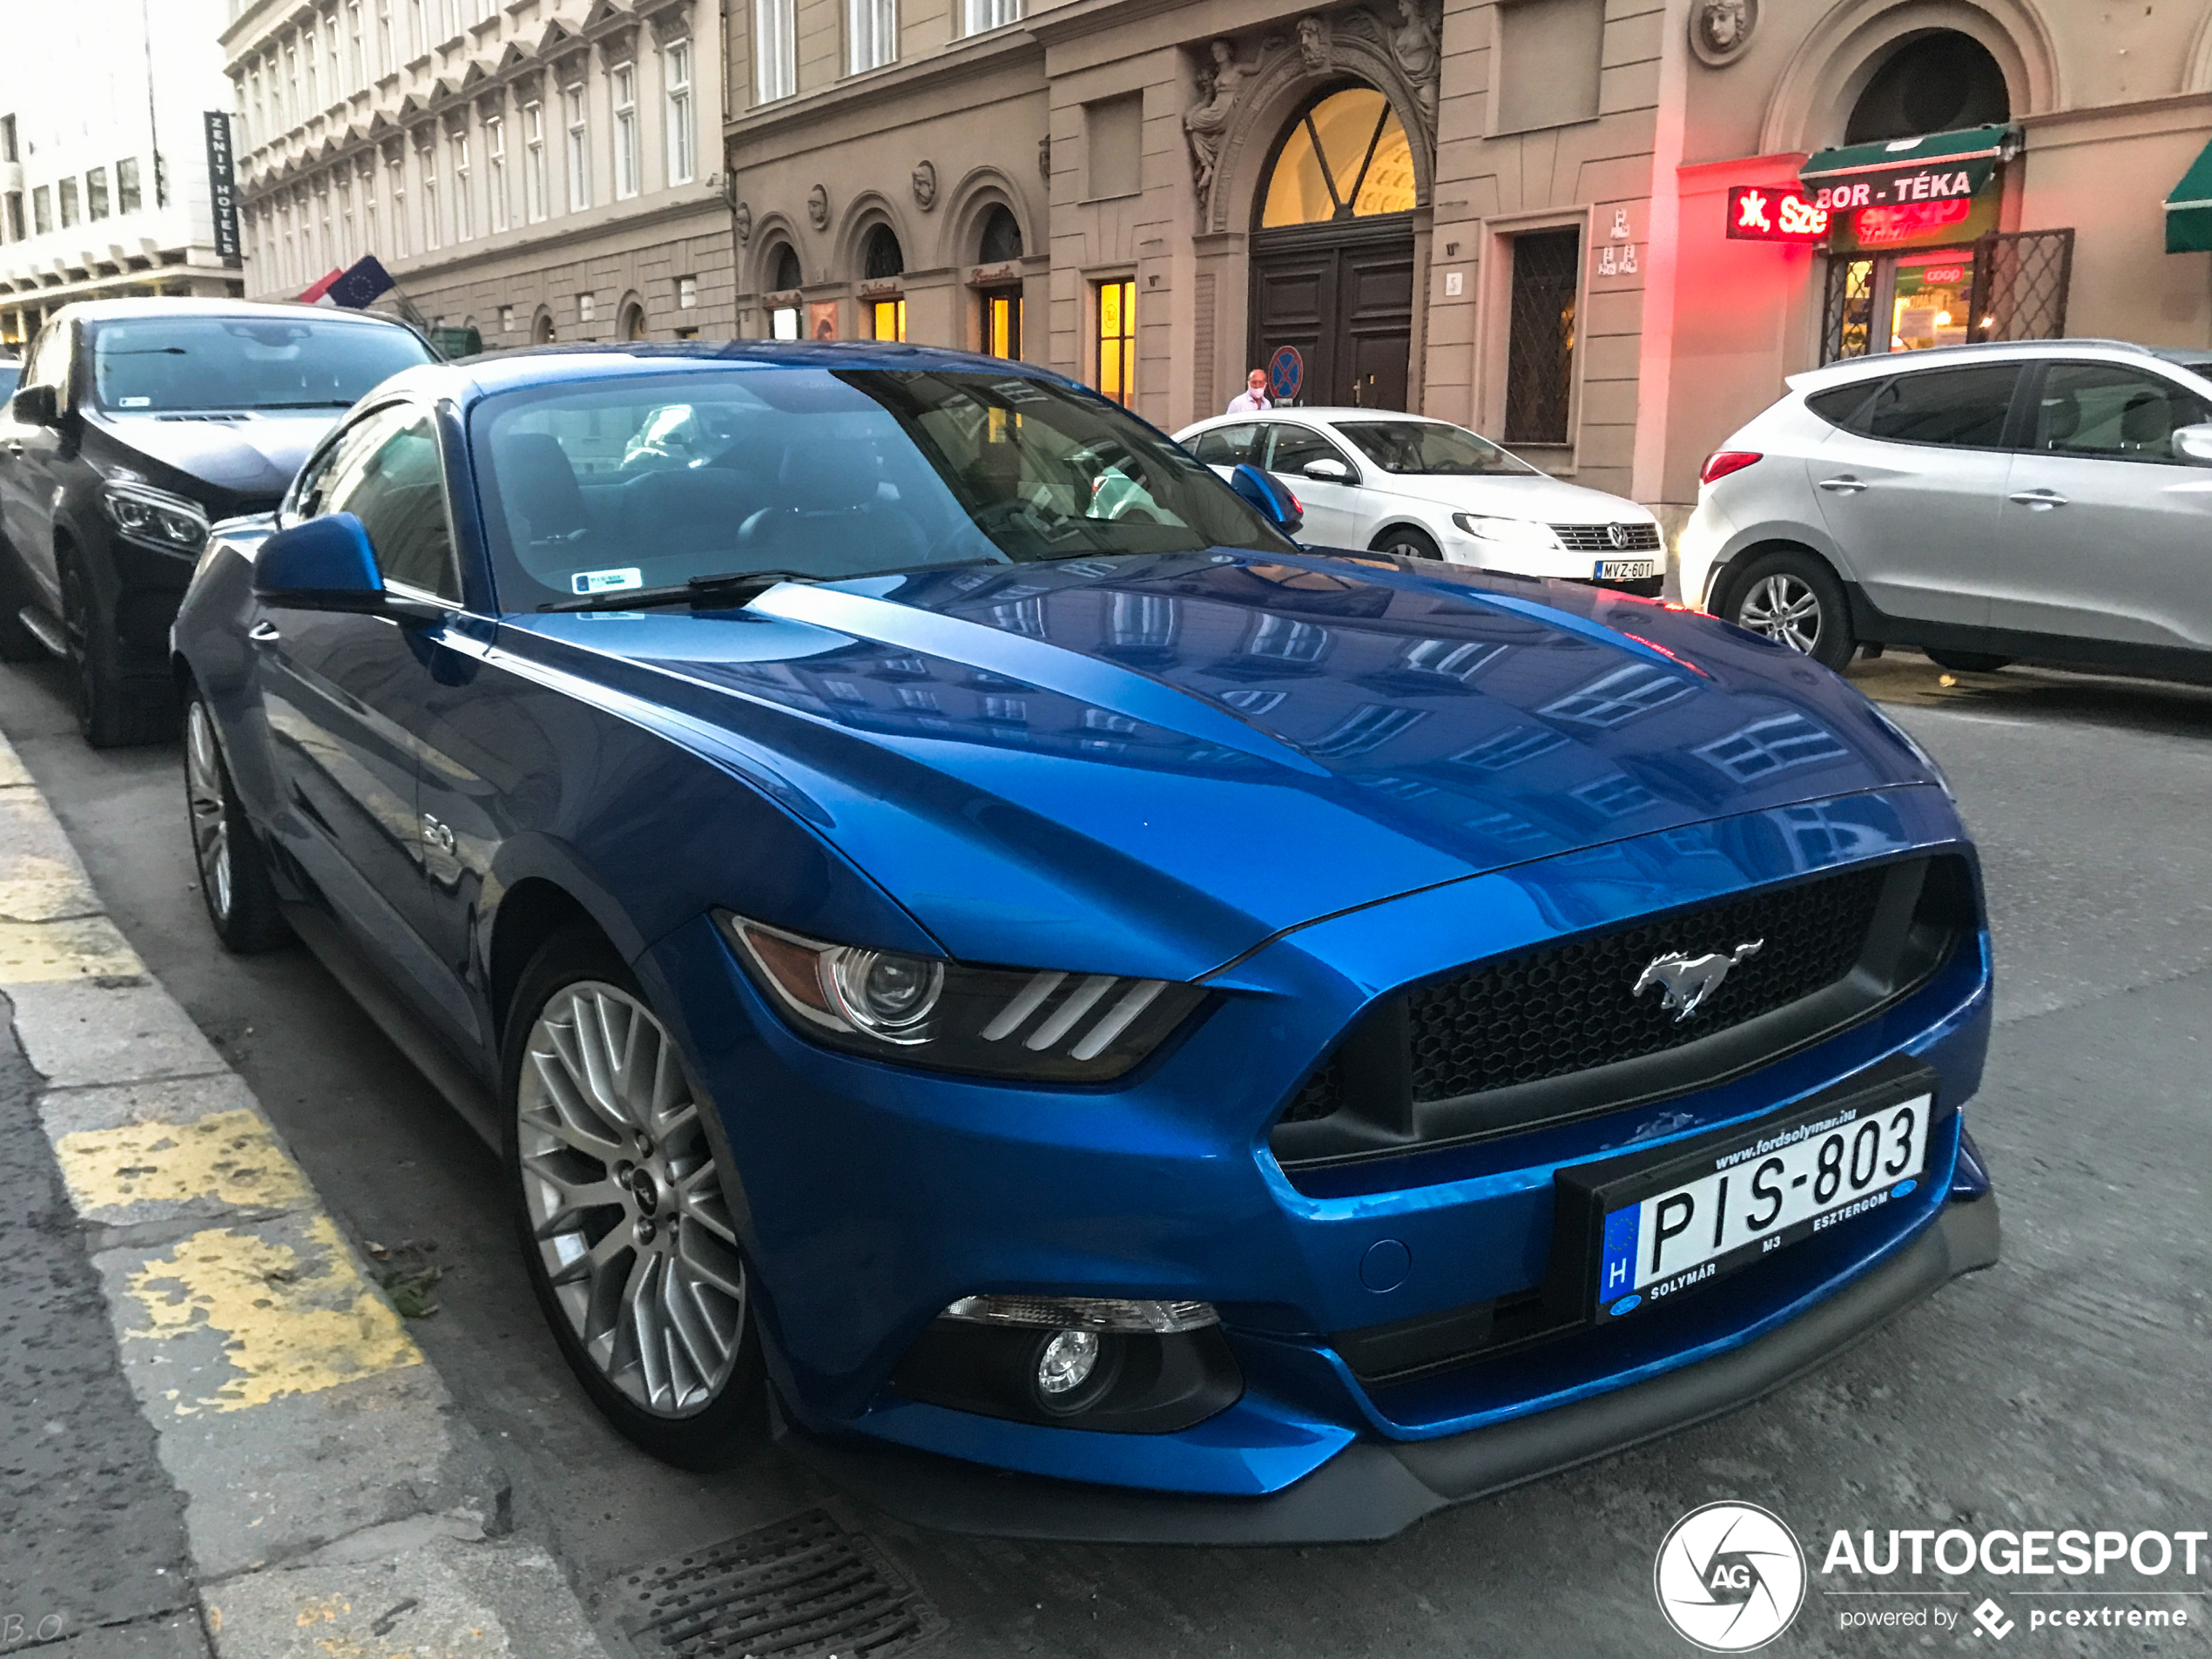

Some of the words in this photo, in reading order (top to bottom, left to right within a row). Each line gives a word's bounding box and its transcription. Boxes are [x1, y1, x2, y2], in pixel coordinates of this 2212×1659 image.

[212, 117, 226, 175] ZENIT
[1815, 183, 1871, 210] BOR
[1894, 170, 1972, 202] TÉKA
[217, 185, 234, 254] HOTELS
[1604, 563, 1650, 577] MVZ-601
[1650, 1106, 1917, 1275] PIS-803
[1608, 1258, 1627, 1289] H
[1650, 1263, 1716, 1301] SOLYMÁR
[1763, 1235, 1782, 1254] M3
[1812, 1190, 1889, 1232] ESZTERGOM
